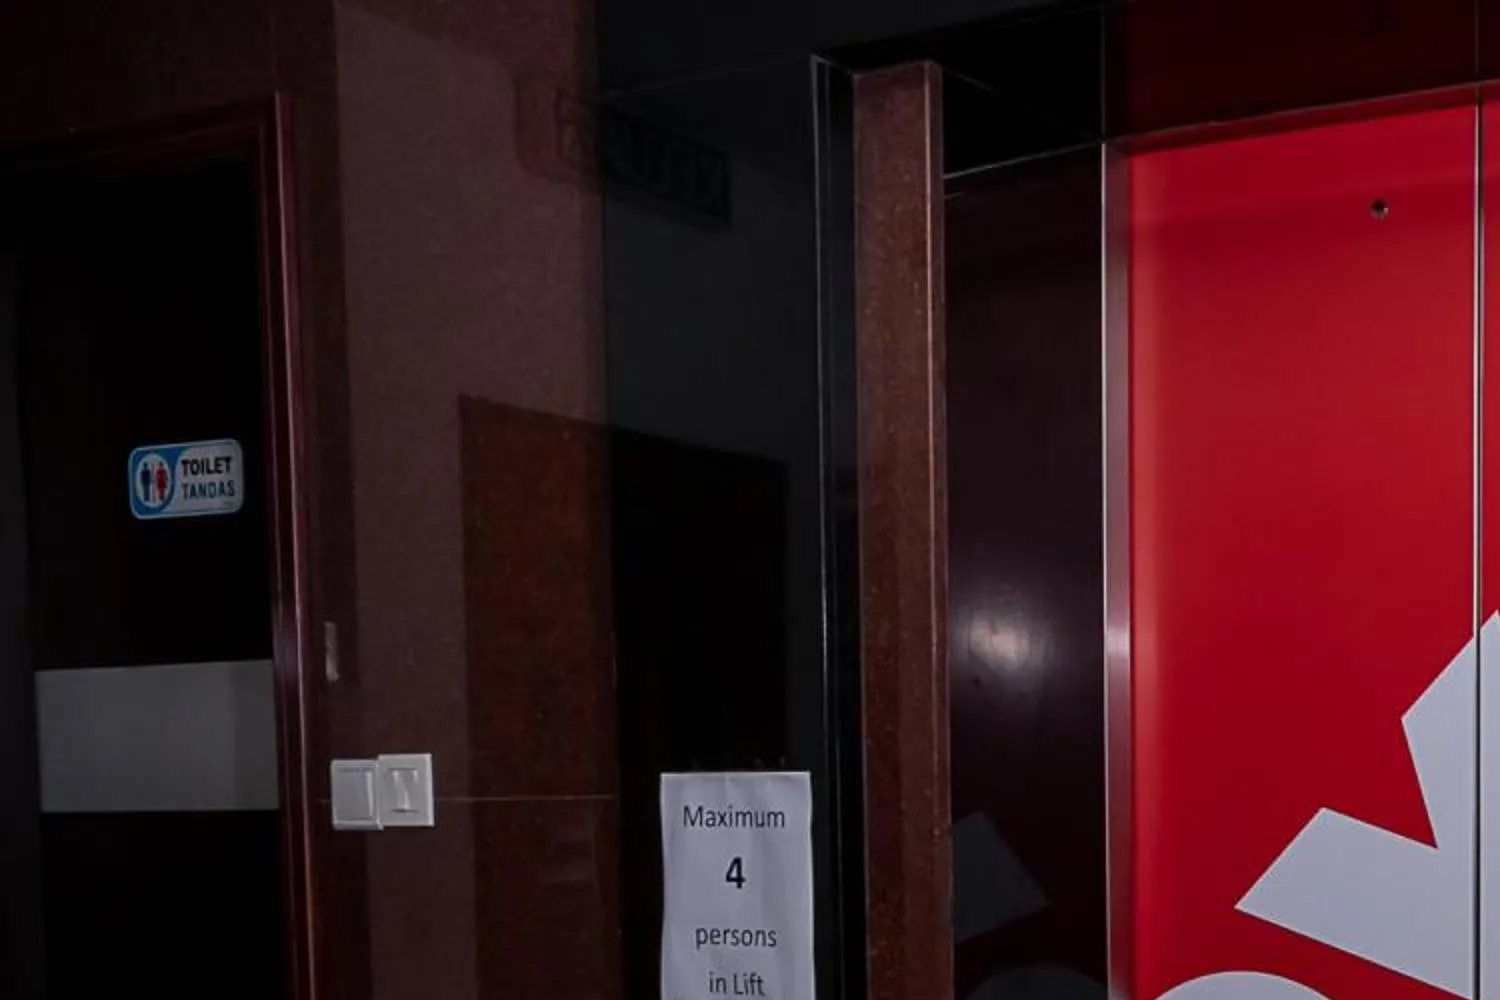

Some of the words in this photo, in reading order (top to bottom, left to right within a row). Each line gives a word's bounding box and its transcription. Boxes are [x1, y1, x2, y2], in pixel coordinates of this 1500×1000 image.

[181, 456, 231, 476] TOILET
[182, 480, 235, 499] TANDAS
[683, 804, 785, 828] Maximum
[725, 856, 746, 889] 4
[695, 927, 777, 950] persons
[709, 970, 727, 995] in
[733, 971, 765, 997] Lift
